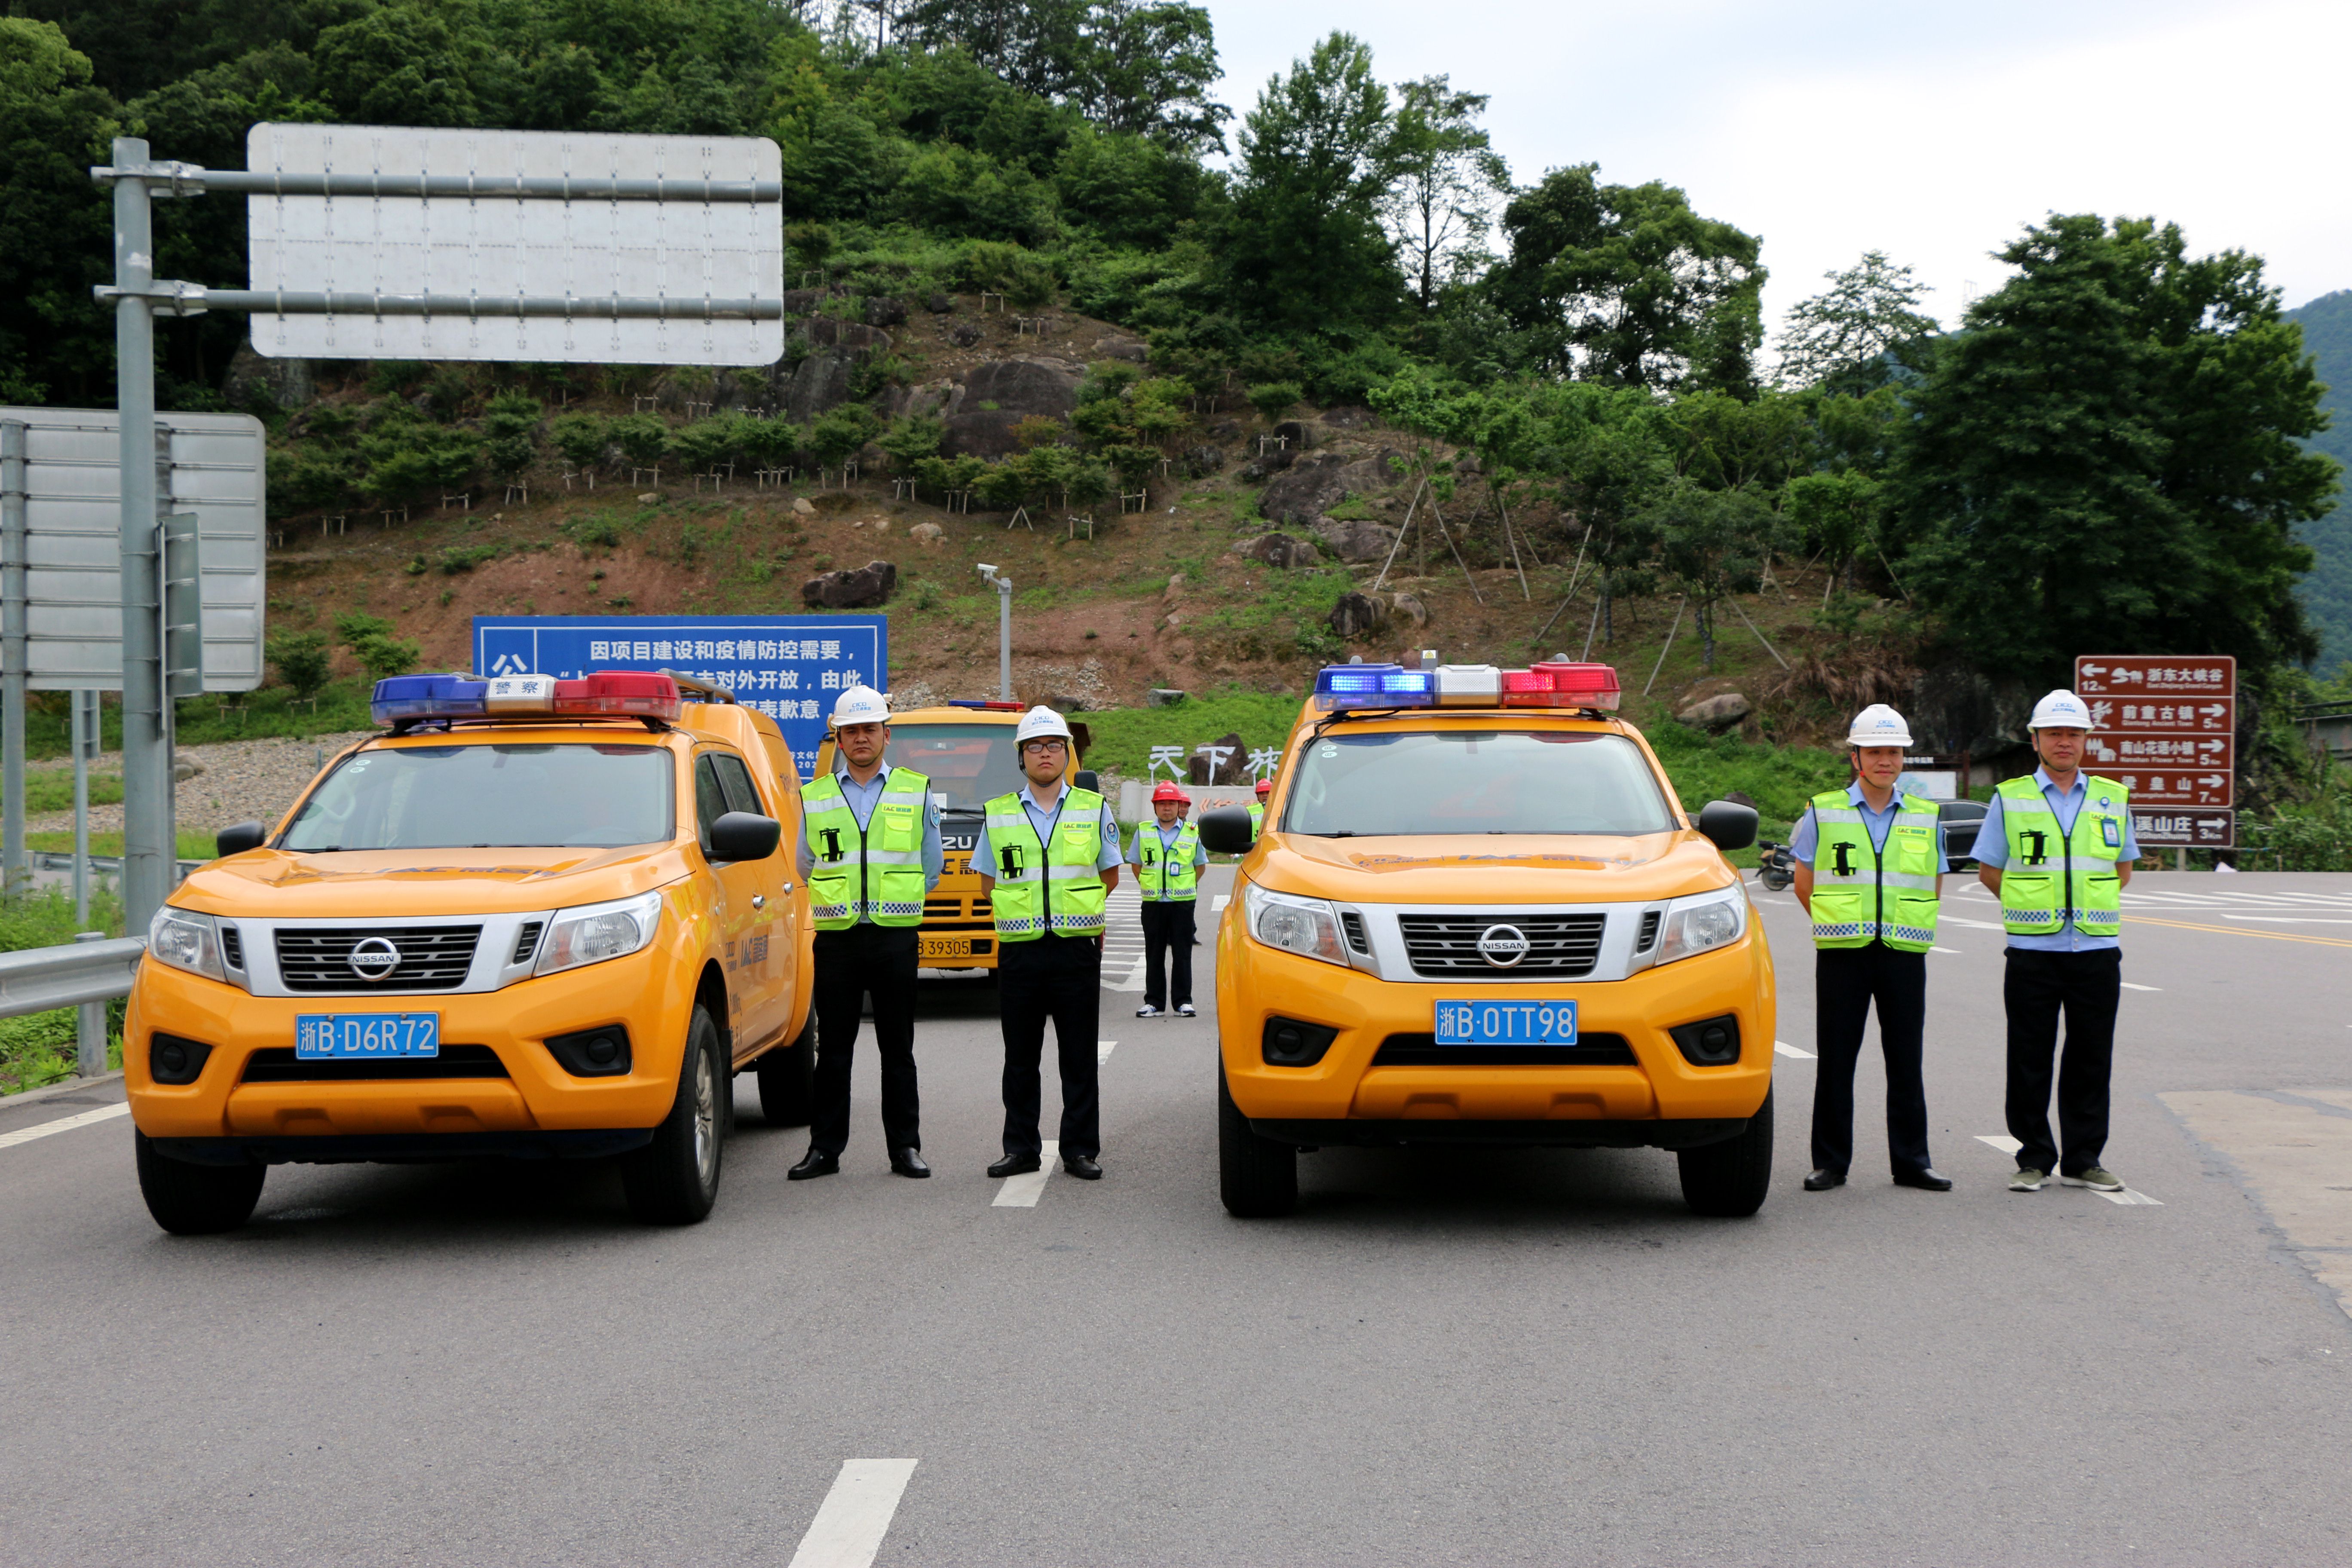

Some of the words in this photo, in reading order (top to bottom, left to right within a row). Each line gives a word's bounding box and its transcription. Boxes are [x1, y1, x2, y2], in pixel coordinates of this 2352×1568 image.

[591, 640, 853, 660] 因项目建设和疫情防控需要，
